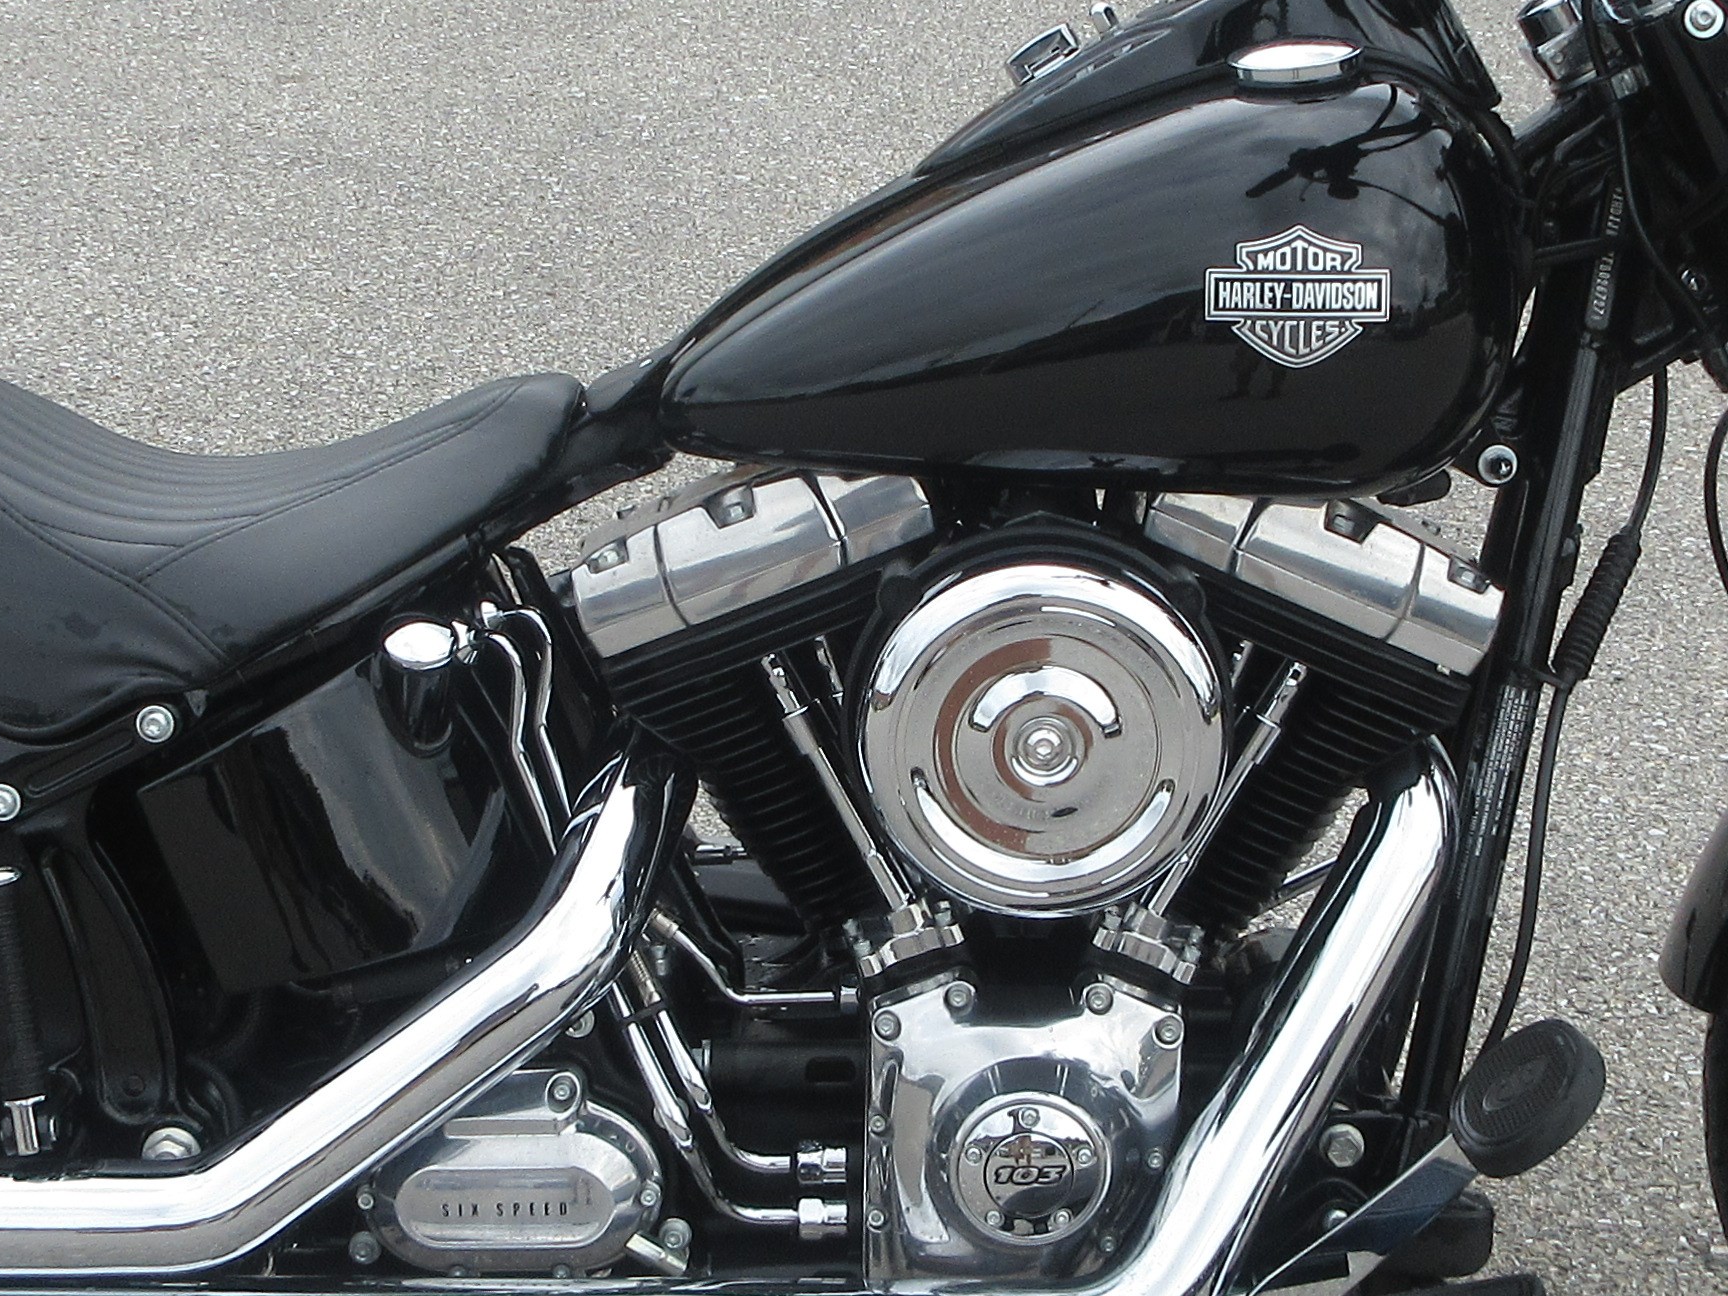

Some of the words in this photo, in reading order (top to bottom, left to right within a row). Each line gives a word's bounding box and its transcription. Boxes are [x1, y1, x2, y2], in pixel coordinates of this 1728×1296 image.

[1257, 240, 1342, 272] MOTOR
[1218, 281, 1379, 310] HARLEY-DAVIDSON
[1255, 319, 1341, 355] CYCLES
[994, 1165, 1067, 1185] 103
[441, 1202, 480, 1217] SIX
[497, 1202, 569, 1217] SPEED
